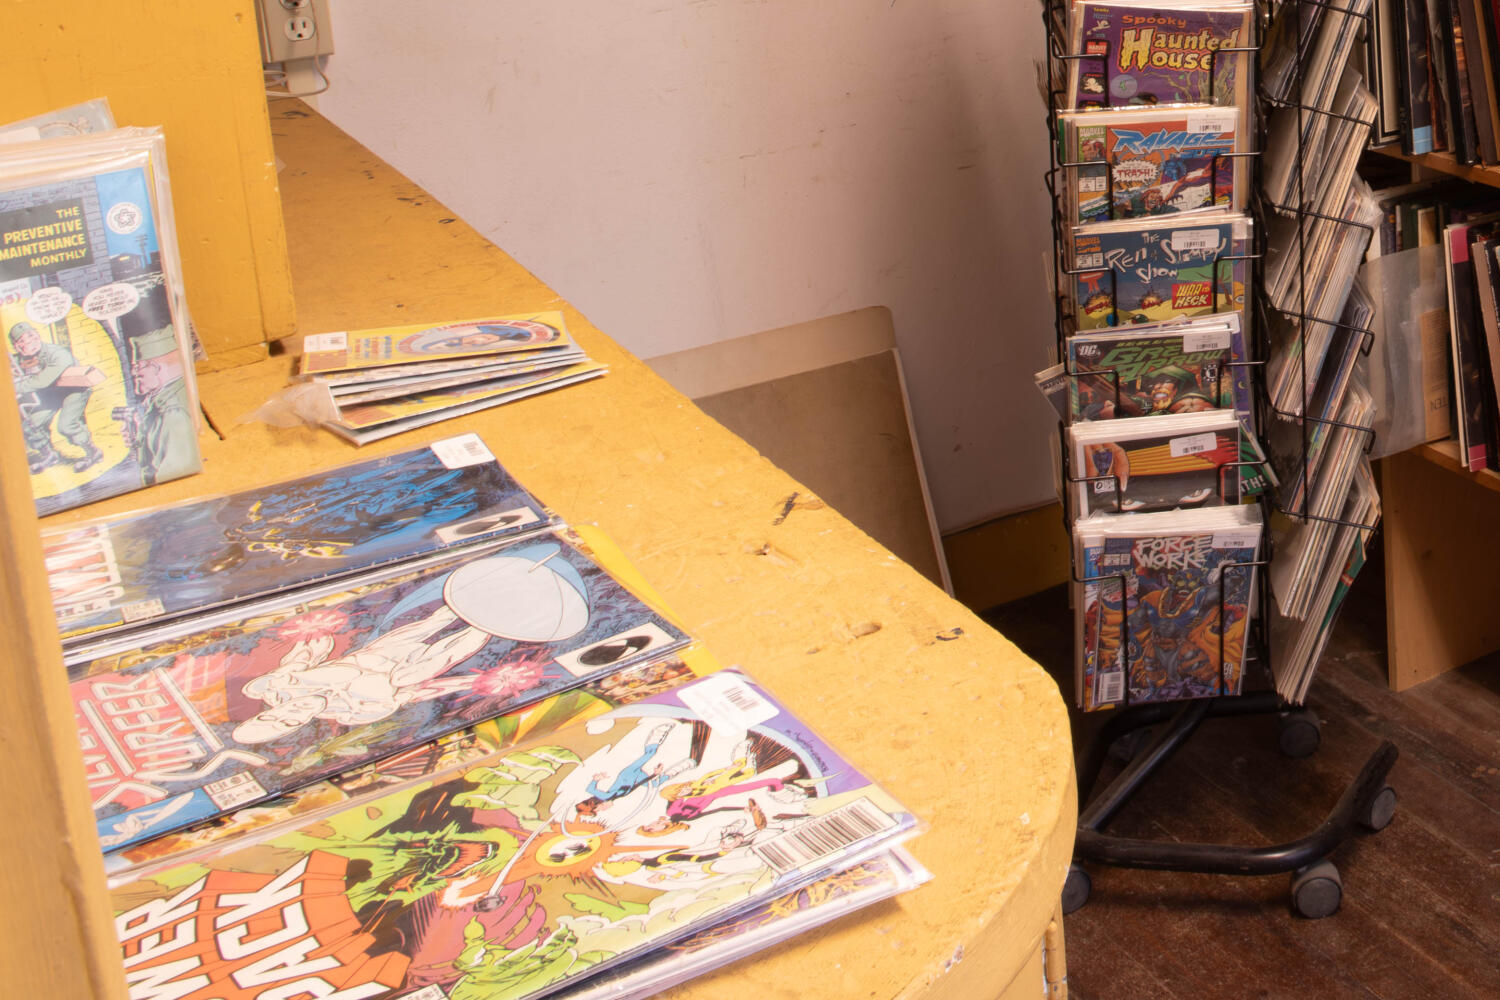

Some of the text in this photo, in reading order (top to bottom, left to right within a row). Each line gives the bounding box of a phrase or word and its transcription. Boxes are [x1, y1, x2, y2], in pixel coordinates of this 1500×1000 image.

[1121, 14, 1187, 28] Spooky
[1119, 26, 1241, 72] Haunted
[1110, 128, 1235, 155] RAVAGE
[1117, 168, 1154, 178] TRASH!
[56, 206, 81, 220] THE
[3, 218, 84, 246] PREVENTIVE
[1141, 232, 1160, 244] THE
[0, 232, 86, 261] MAINTENANCE
[30, 247, 88, 268] MONTHLY
[1135, 263, 1178, 284] SHOW
[1174, 294, 1209, 308] HECK
[1176, 284, 1202, 297] WAR
[1079, 344, 1098, 357] DC
[1100, 344, 1184, 367] GRE
[1106, 349, 1224, 383] ARROW
[1135, 534, 1214, 552] FORCE
[91, 668, 250, 782] SURFER
